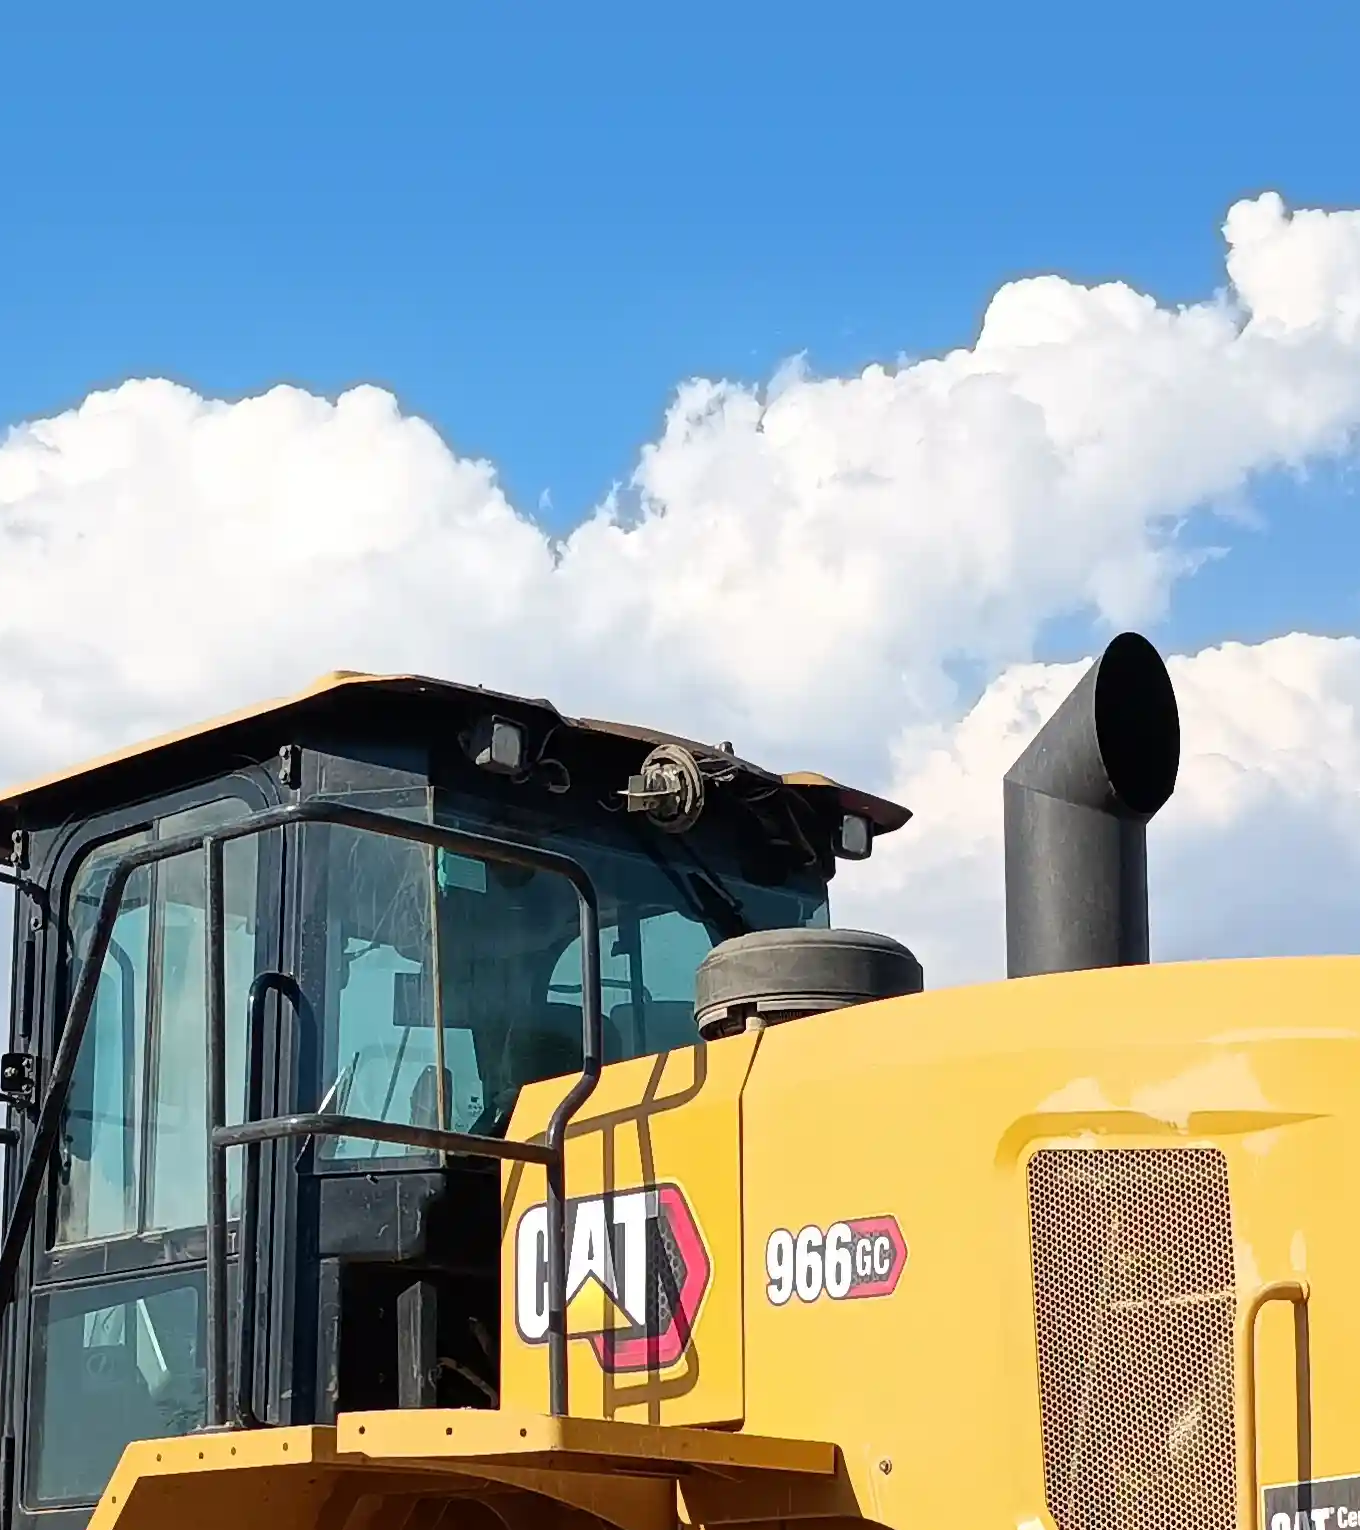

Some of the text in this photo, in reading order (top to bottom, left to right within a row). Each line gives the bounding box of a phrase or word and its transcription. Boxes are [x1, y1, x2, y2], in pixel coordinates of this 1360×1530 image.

[517, 1189, 659, 1339] CAT
[767, 1222, 891, 1304] 966 GC
